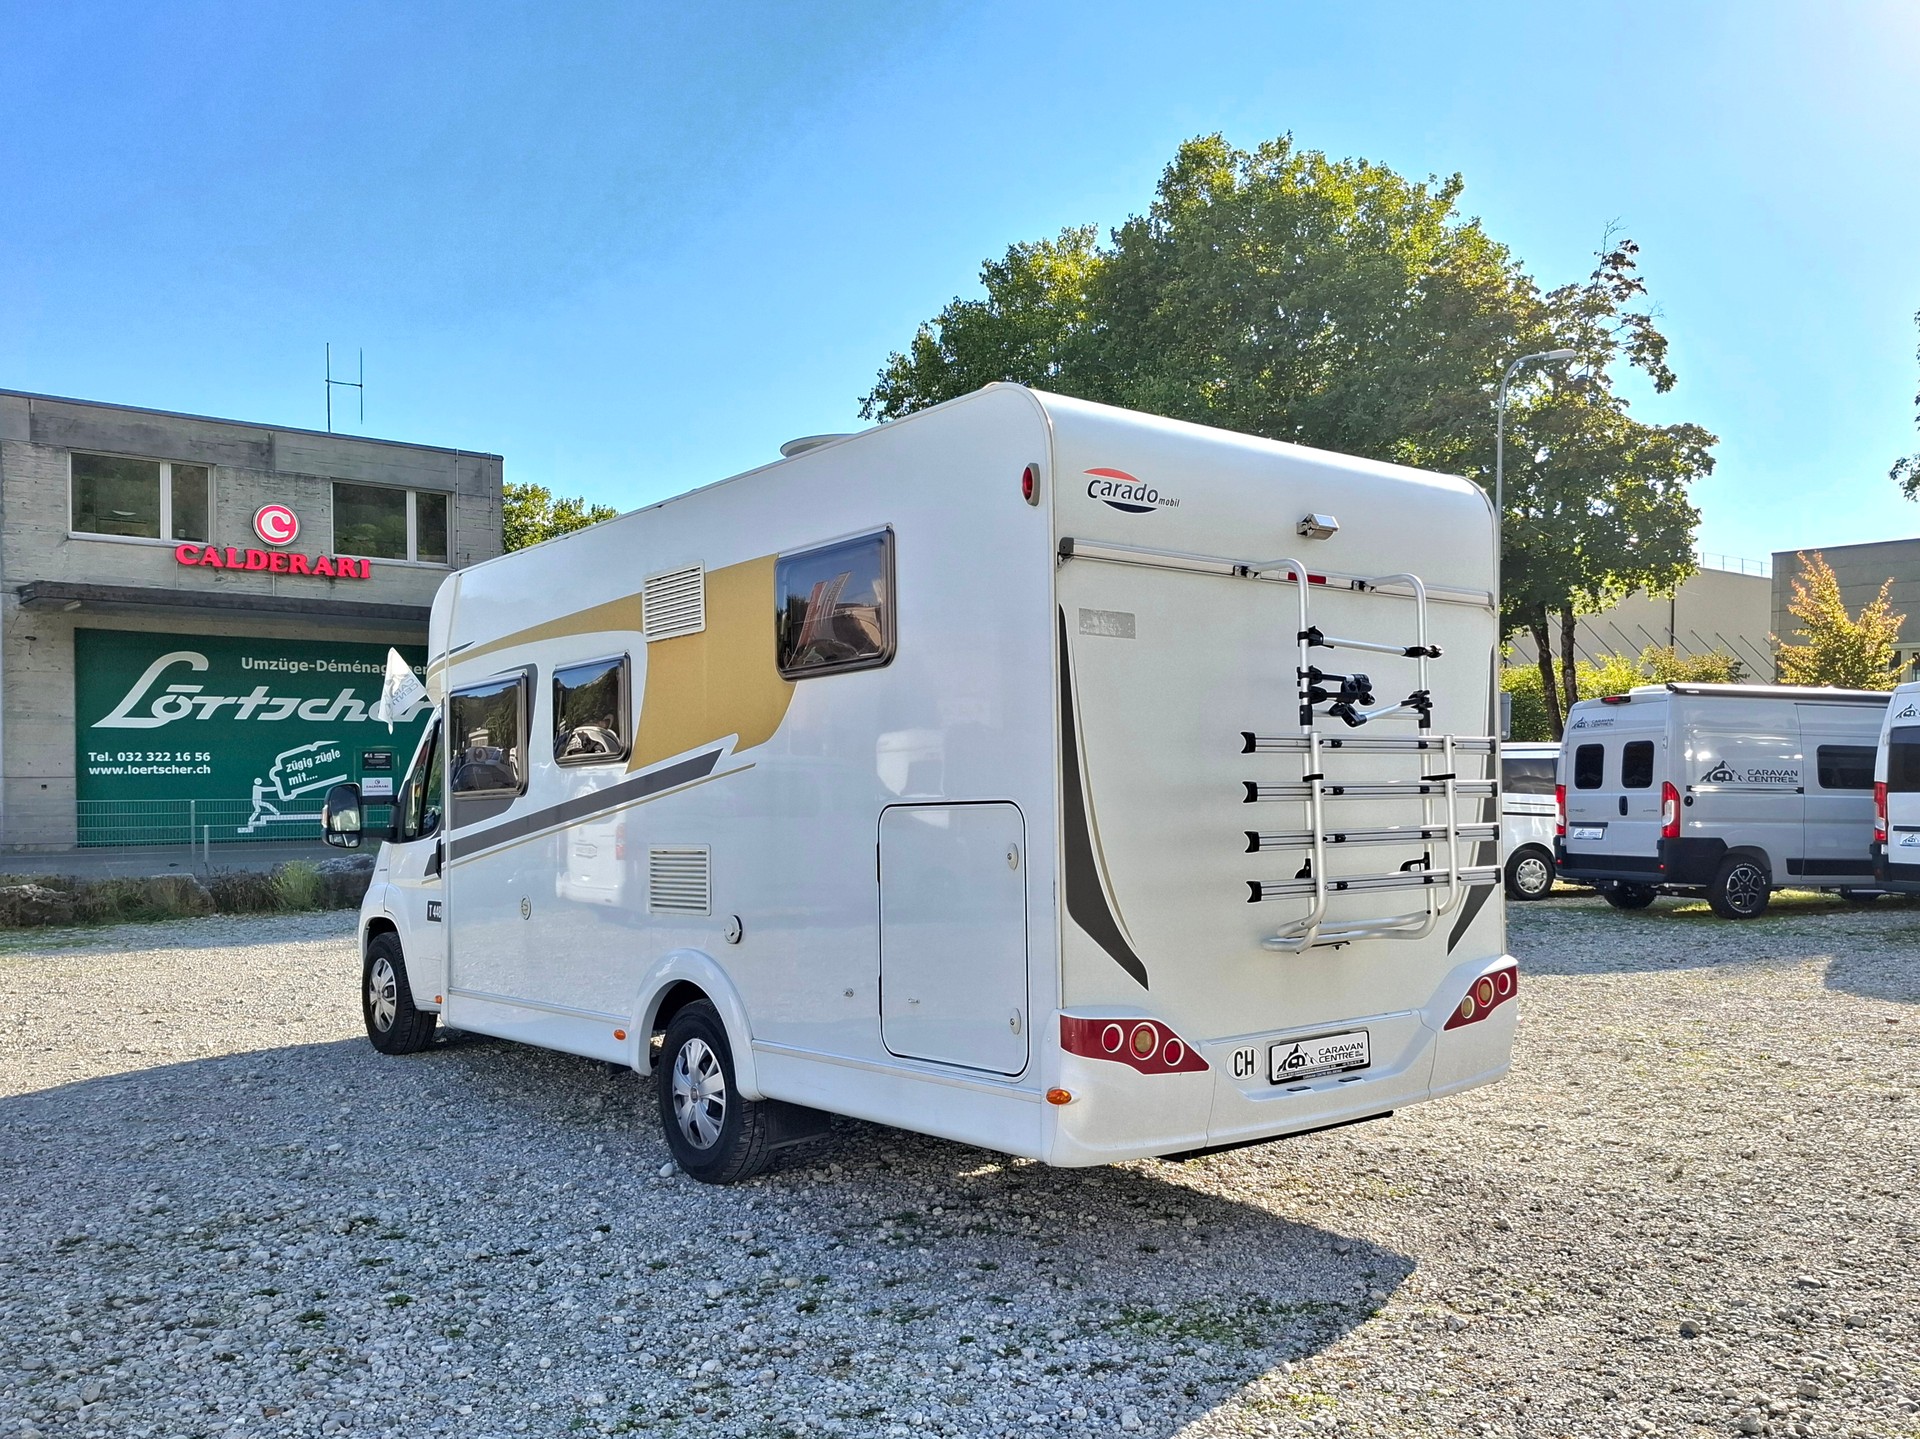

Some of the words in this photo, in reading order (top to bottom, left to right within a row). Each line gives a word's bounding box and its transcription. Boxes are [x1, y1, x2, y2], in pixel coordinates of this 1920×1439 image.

[1158, 497, 1180, 508] mobil
[260, 510, 291, 538] C
[175, 543, 371, 579] CALDERARI
[88, 752, 113, 762] Tel.
[117, 752, 143, 762] 032
[146, 752, 171, 762] 322
[175, 752, 191, 762] 16
[194, 752, 211, 762] 56
[285, 757, 314, 773] zügig
[314, 749, 341, 765] zügle
[88, 765, 211, 775] www.loertscher.ch
[1747, 769, 1798, 777] CARAVAN
[1747, 775, 1788, 783] CENTRE
[1318, 1042, 1364, 1056] CARAVAN
[1234, 1049, 1255, 1077] CH
[1318, 1051, 1355, 1063] CENTRE
